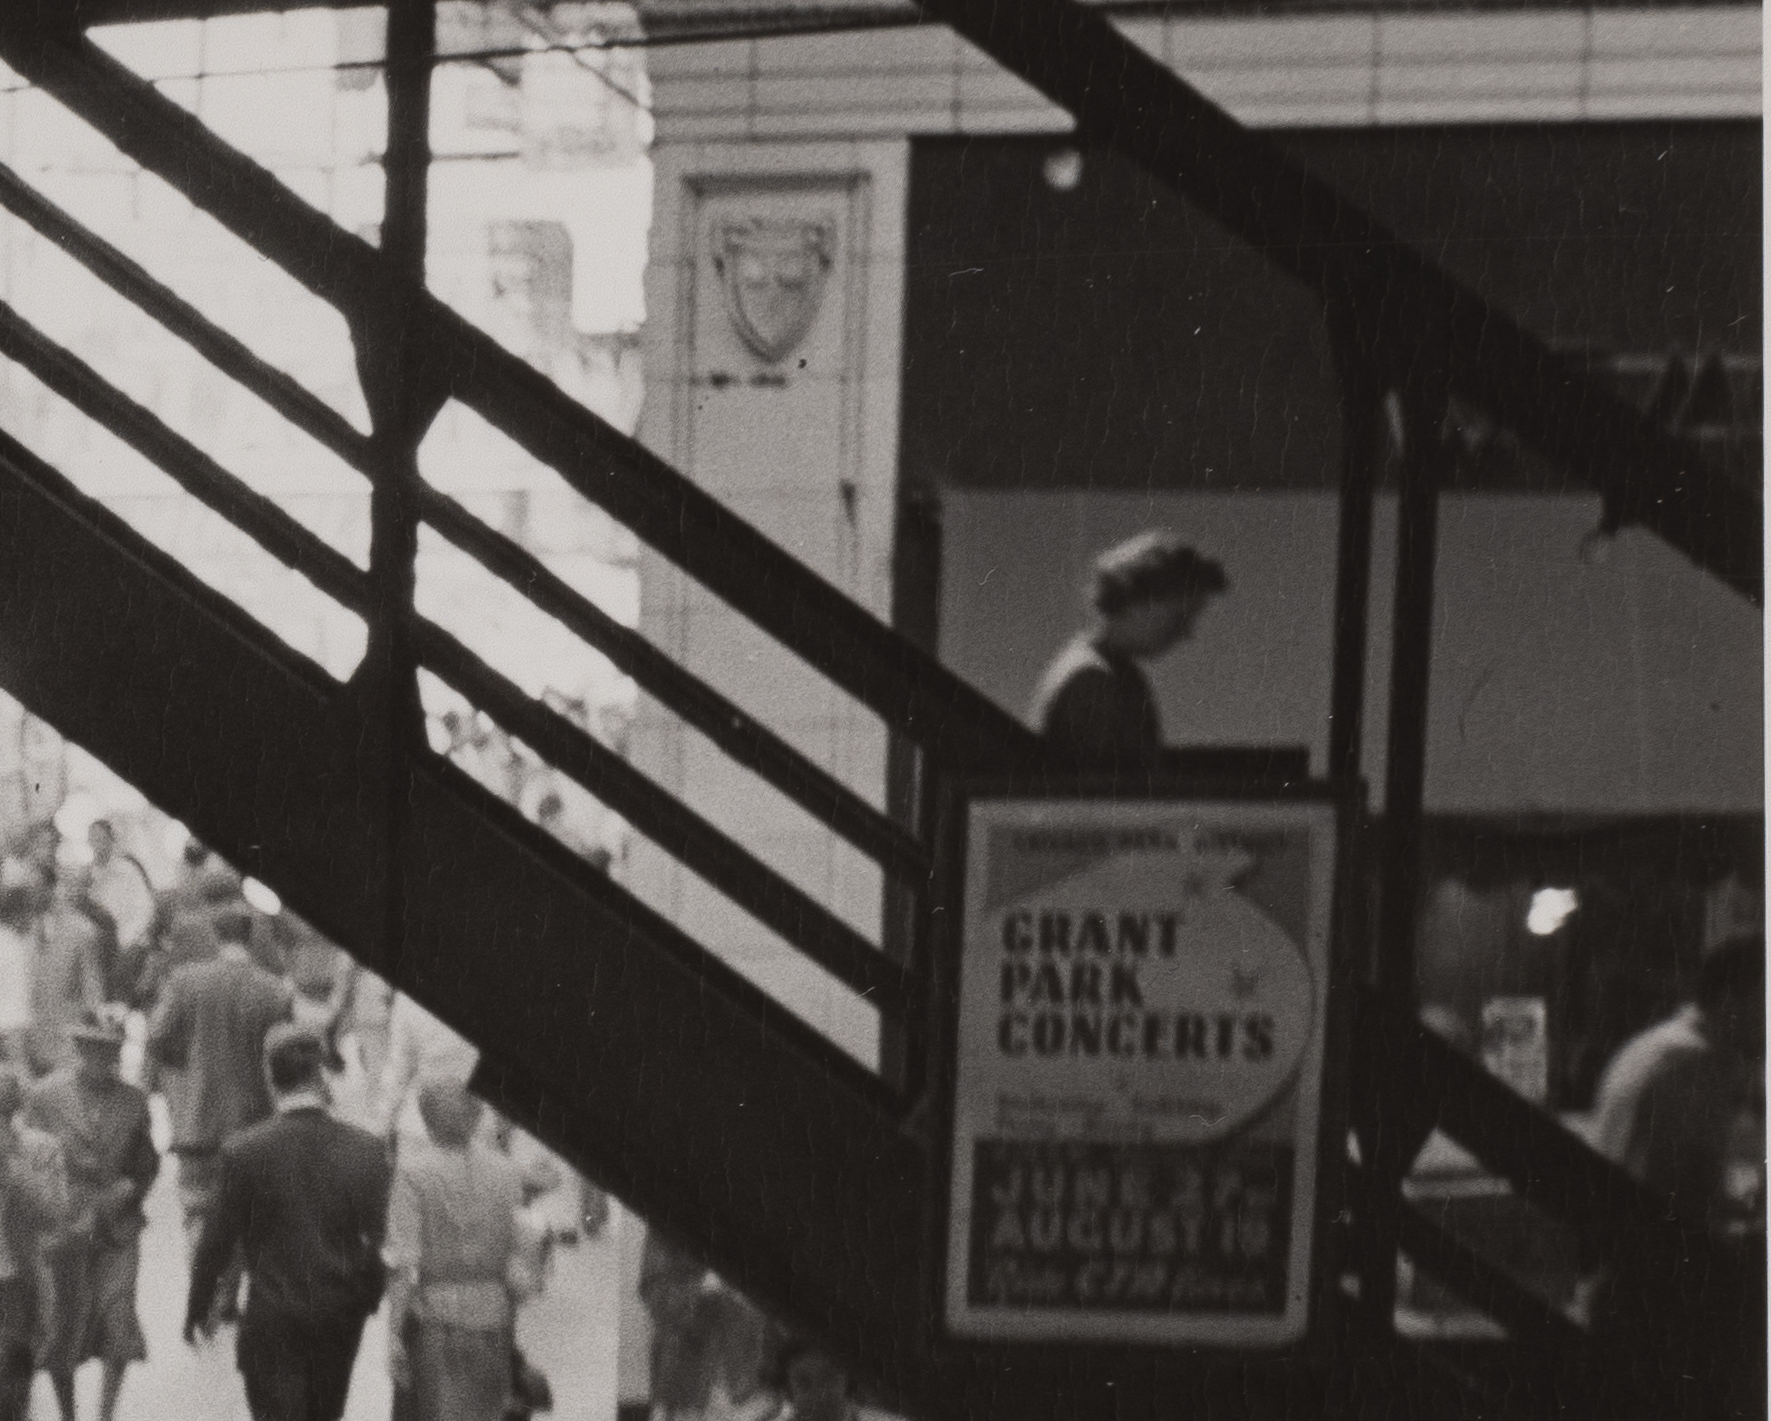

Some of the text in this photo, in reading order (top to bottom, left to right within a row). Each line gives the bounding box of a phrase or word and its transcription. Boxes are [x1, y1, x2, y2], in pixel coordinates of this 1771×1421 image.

[1001, 909, 1179, 957] GRANT
[998, 961, 1145, 1008] PARK
[996, 1011, 1277, 1061] CONCERTS
[990, 1209, 1203, 1254] AUGUST
